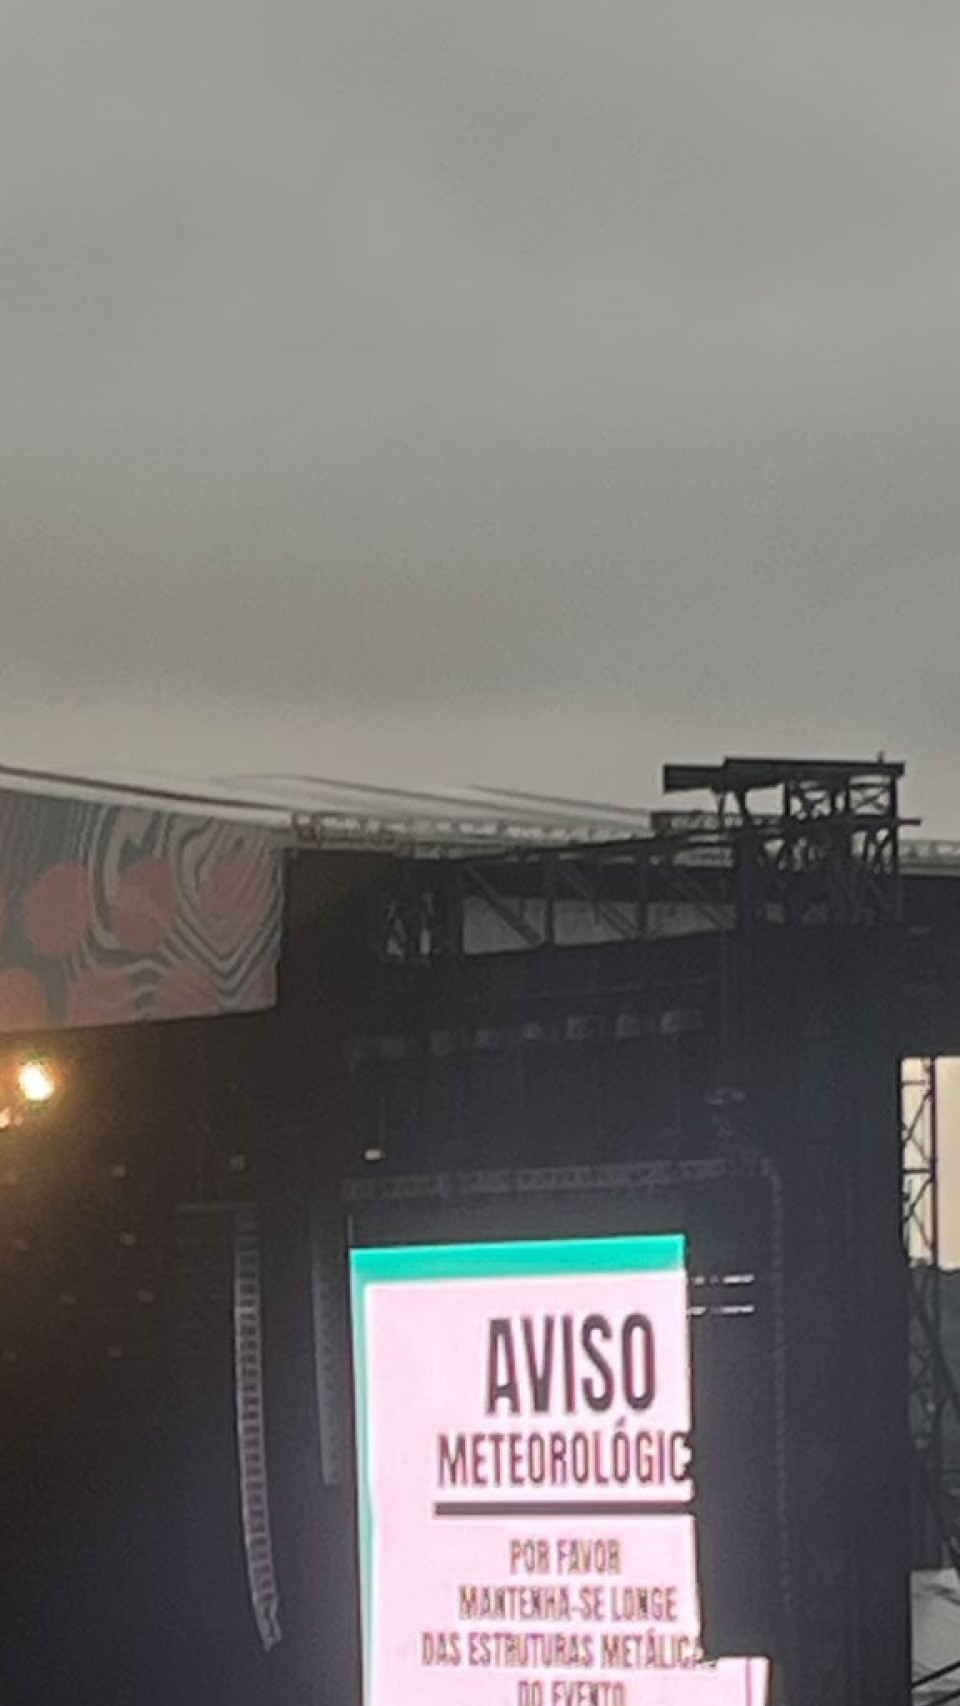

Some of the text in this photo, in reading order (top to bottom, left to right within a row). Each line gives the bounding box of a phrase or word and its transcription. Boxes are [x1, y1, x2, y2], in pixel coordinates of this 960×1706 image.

[486, 1312, 657, 1416] AVISO
[437, 1417, 692, 1488] METEOROLÓGIC
[510, 1538, 621, 1575] POR FAVOR
[459, 1584, 678, 1621] MANTENHA-SE LONGE
[421, 1628, 716, 1669] DAS ESTRUTURAS METÁLICA
